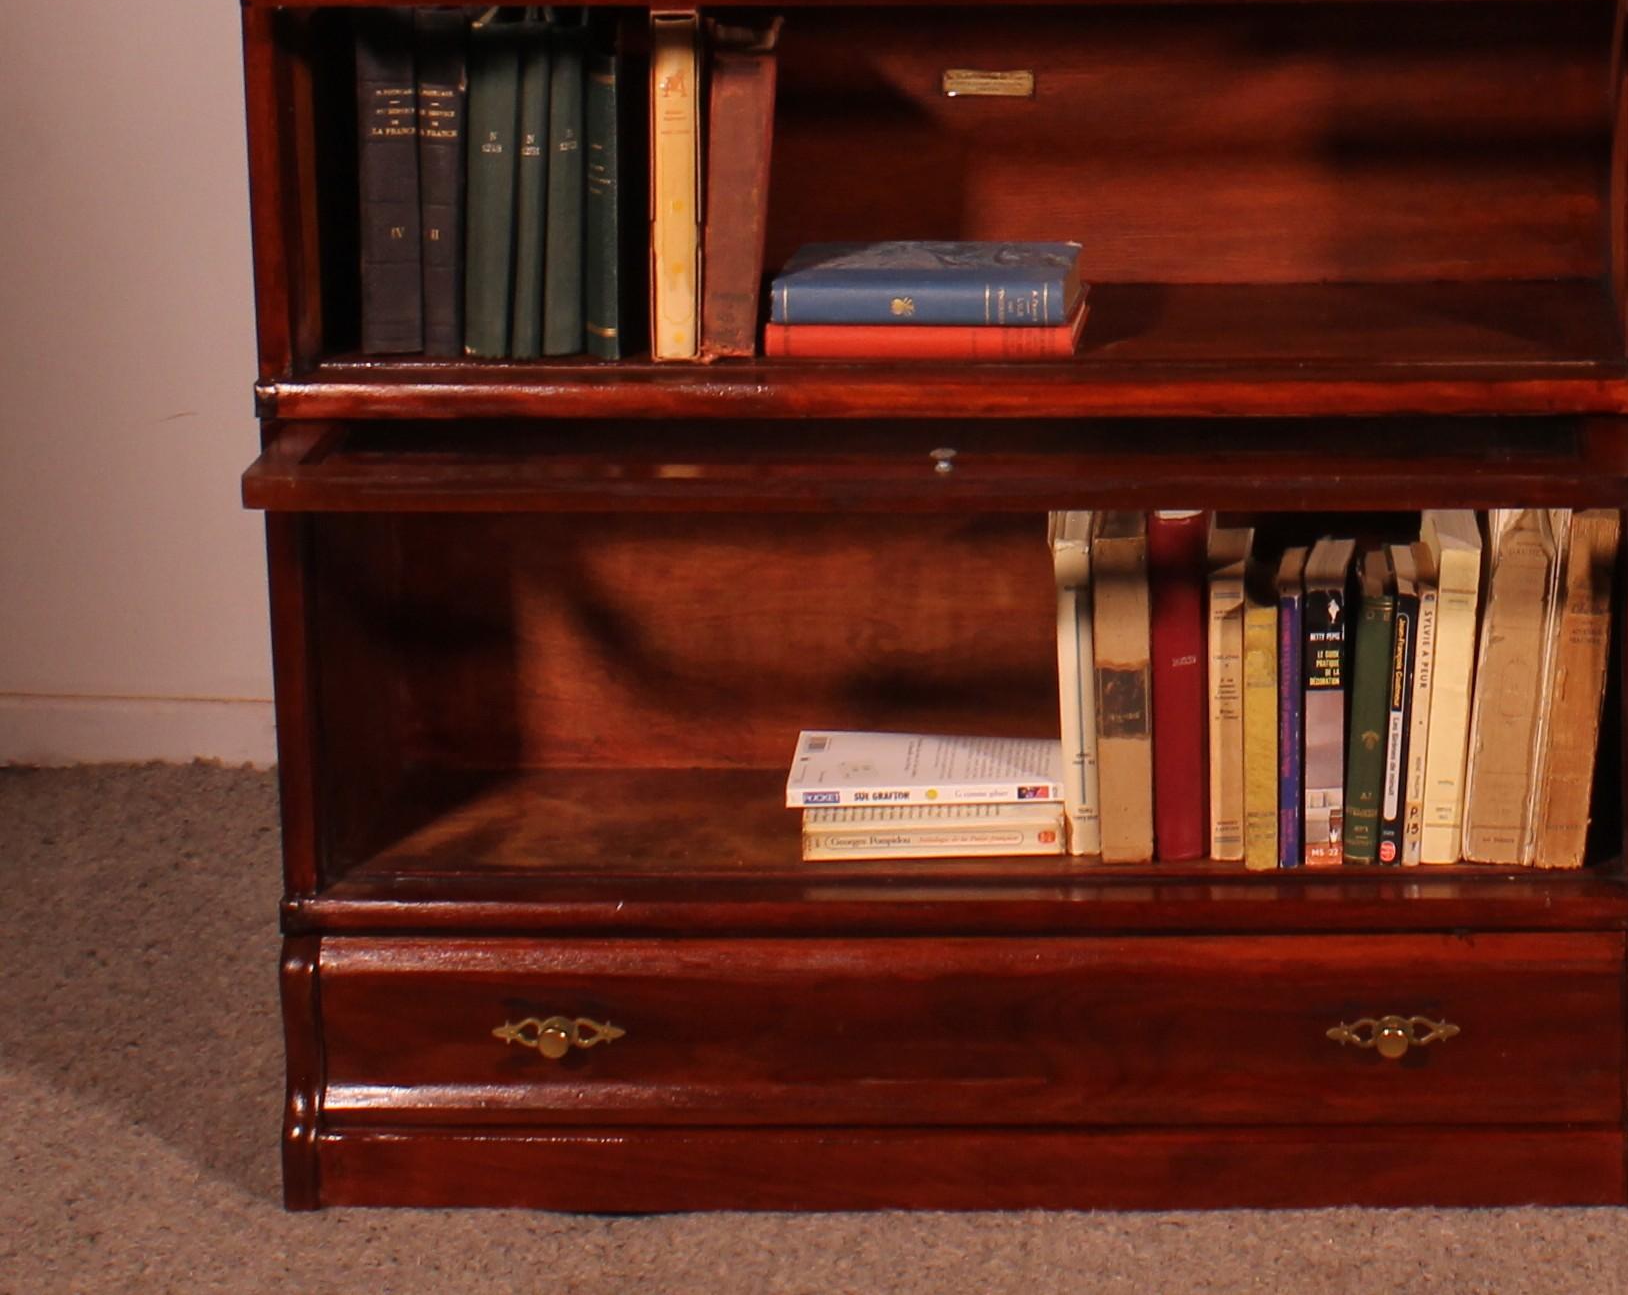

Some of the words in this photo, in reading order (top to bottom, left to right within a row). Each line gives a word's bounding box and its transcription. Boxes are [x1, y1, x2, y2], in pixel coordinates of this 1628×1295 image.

[1420, 609, 1434, 647] SYLVIE
[1316, 650, 1324, 659] LE
[1324, 650, 1340, 659] GUIDE
[1315, 659, 1340, 668] PRATIQUE
[1324, 668, 1332, 677] DE
[1332, 668, 1340, 677] LA
[1418, 661, 1431, 690] PEUR
[853, 791, 871, 802] SUE
[871, 790, 911, 802] GRAFTON
[830, 835, 867, 848] Georges
[868, 834, 912, 847] Pompidou
[1311, 848, 1325, 857] MS
